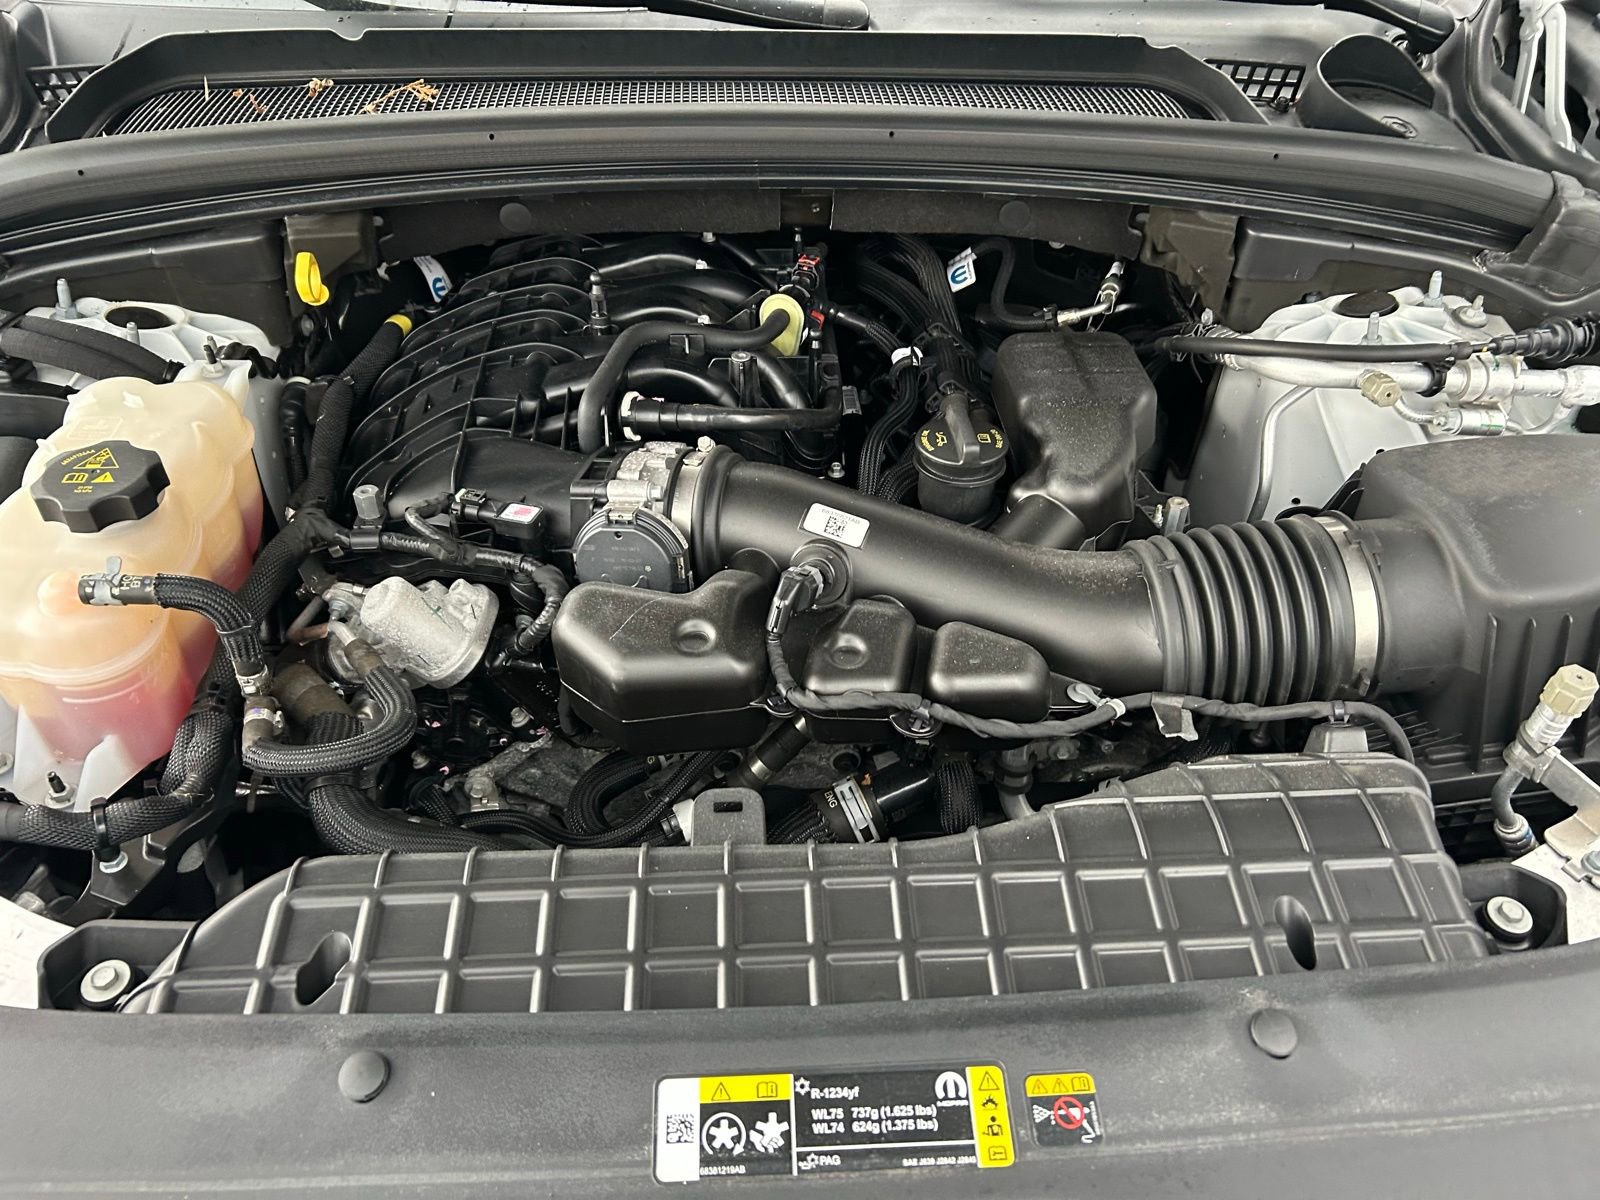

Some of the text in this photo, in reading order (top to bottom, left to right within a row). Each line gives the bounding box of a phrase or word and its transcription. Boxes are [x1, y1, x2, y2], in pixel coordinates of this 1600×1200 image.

[824, 790, 838, 809] ENG
[810, 1086, 860, 1100] R-1234yf
[811, 1104, 937, 1120] WL75 737g (1.625 lbs)
[811, 1118, 939, 1134] WL74 624g (1.375 lbs)
[820, 1154, 841, 1165] PAG
